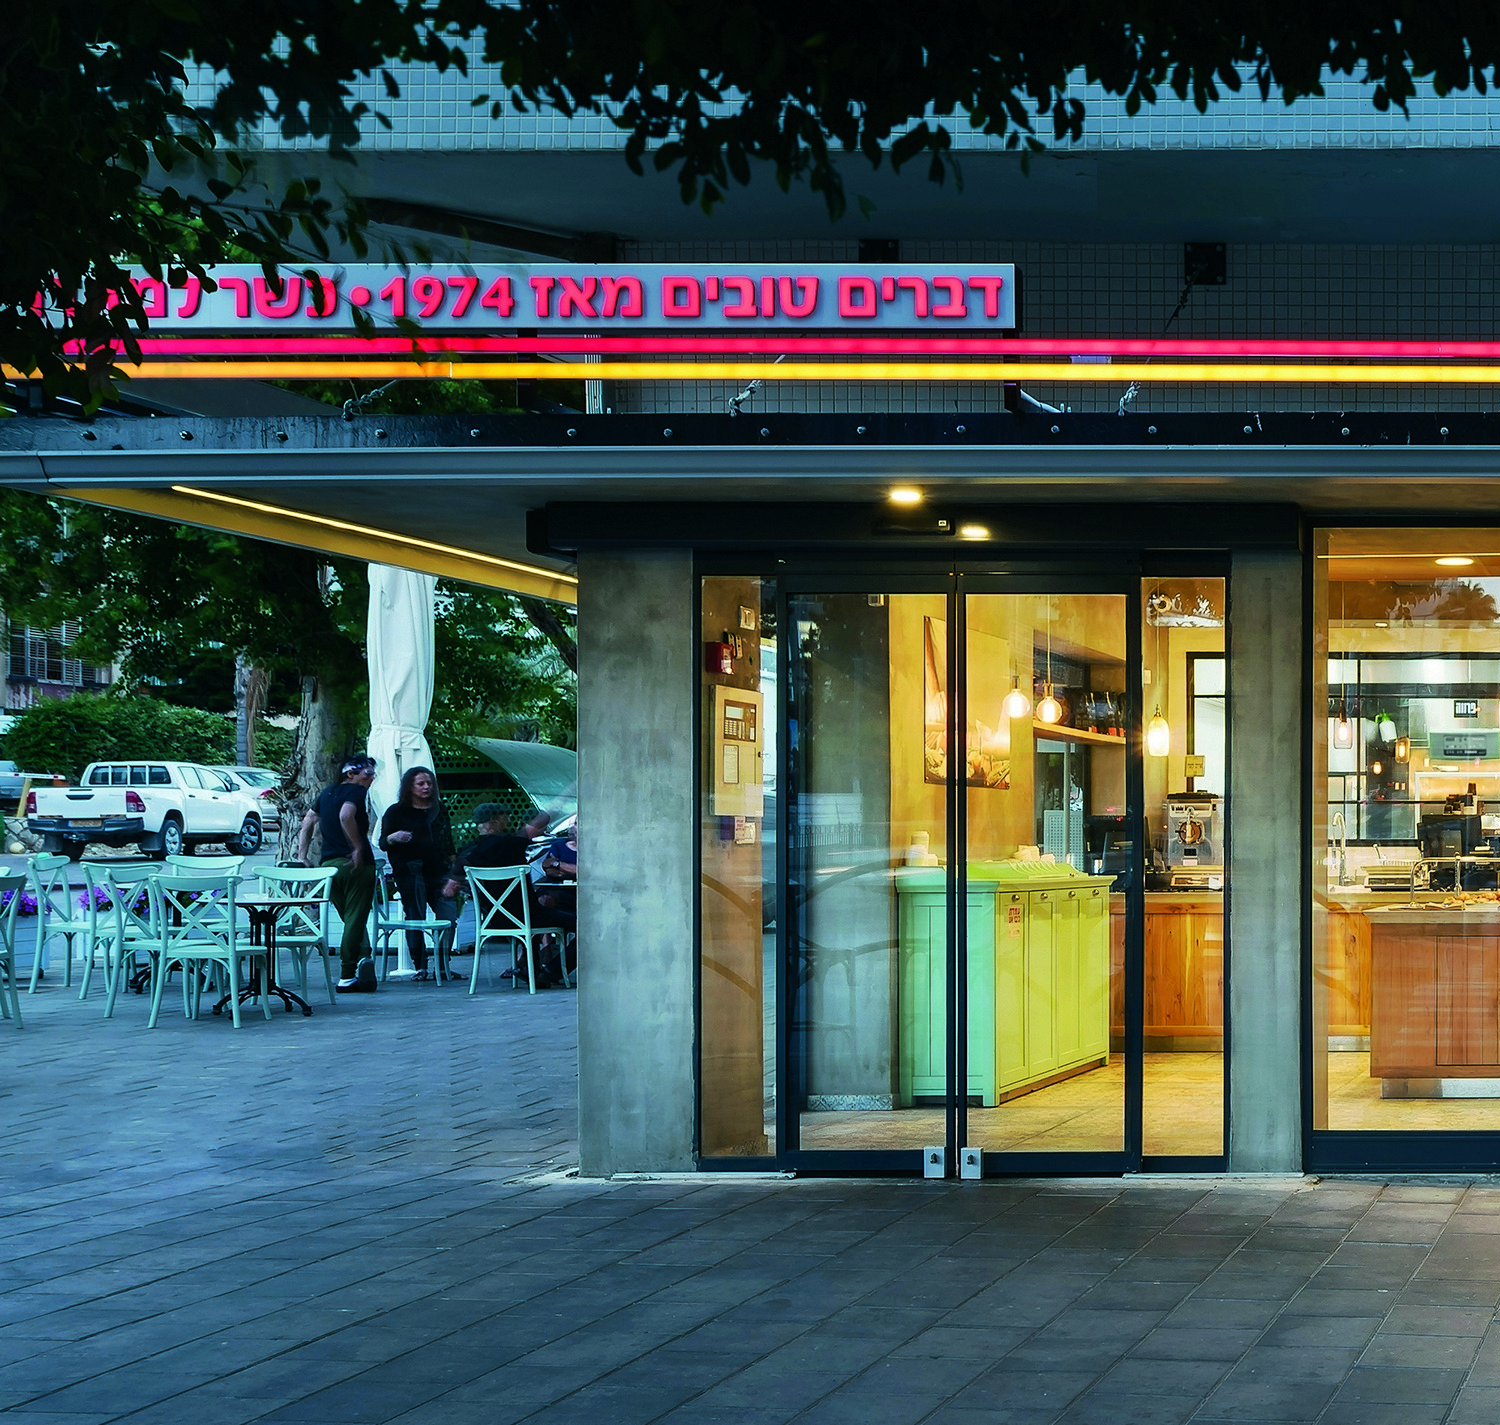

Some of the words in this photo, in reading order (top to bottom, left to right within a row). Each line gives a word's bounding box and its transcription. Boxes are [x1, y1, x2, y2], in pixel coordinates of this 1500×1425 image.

[379, 275, 516, 318] 1974
[529, 275, 644, 318] מאז
[661, 275, 820, 318] טובים
[839, 275, 1003, 318] דברים
